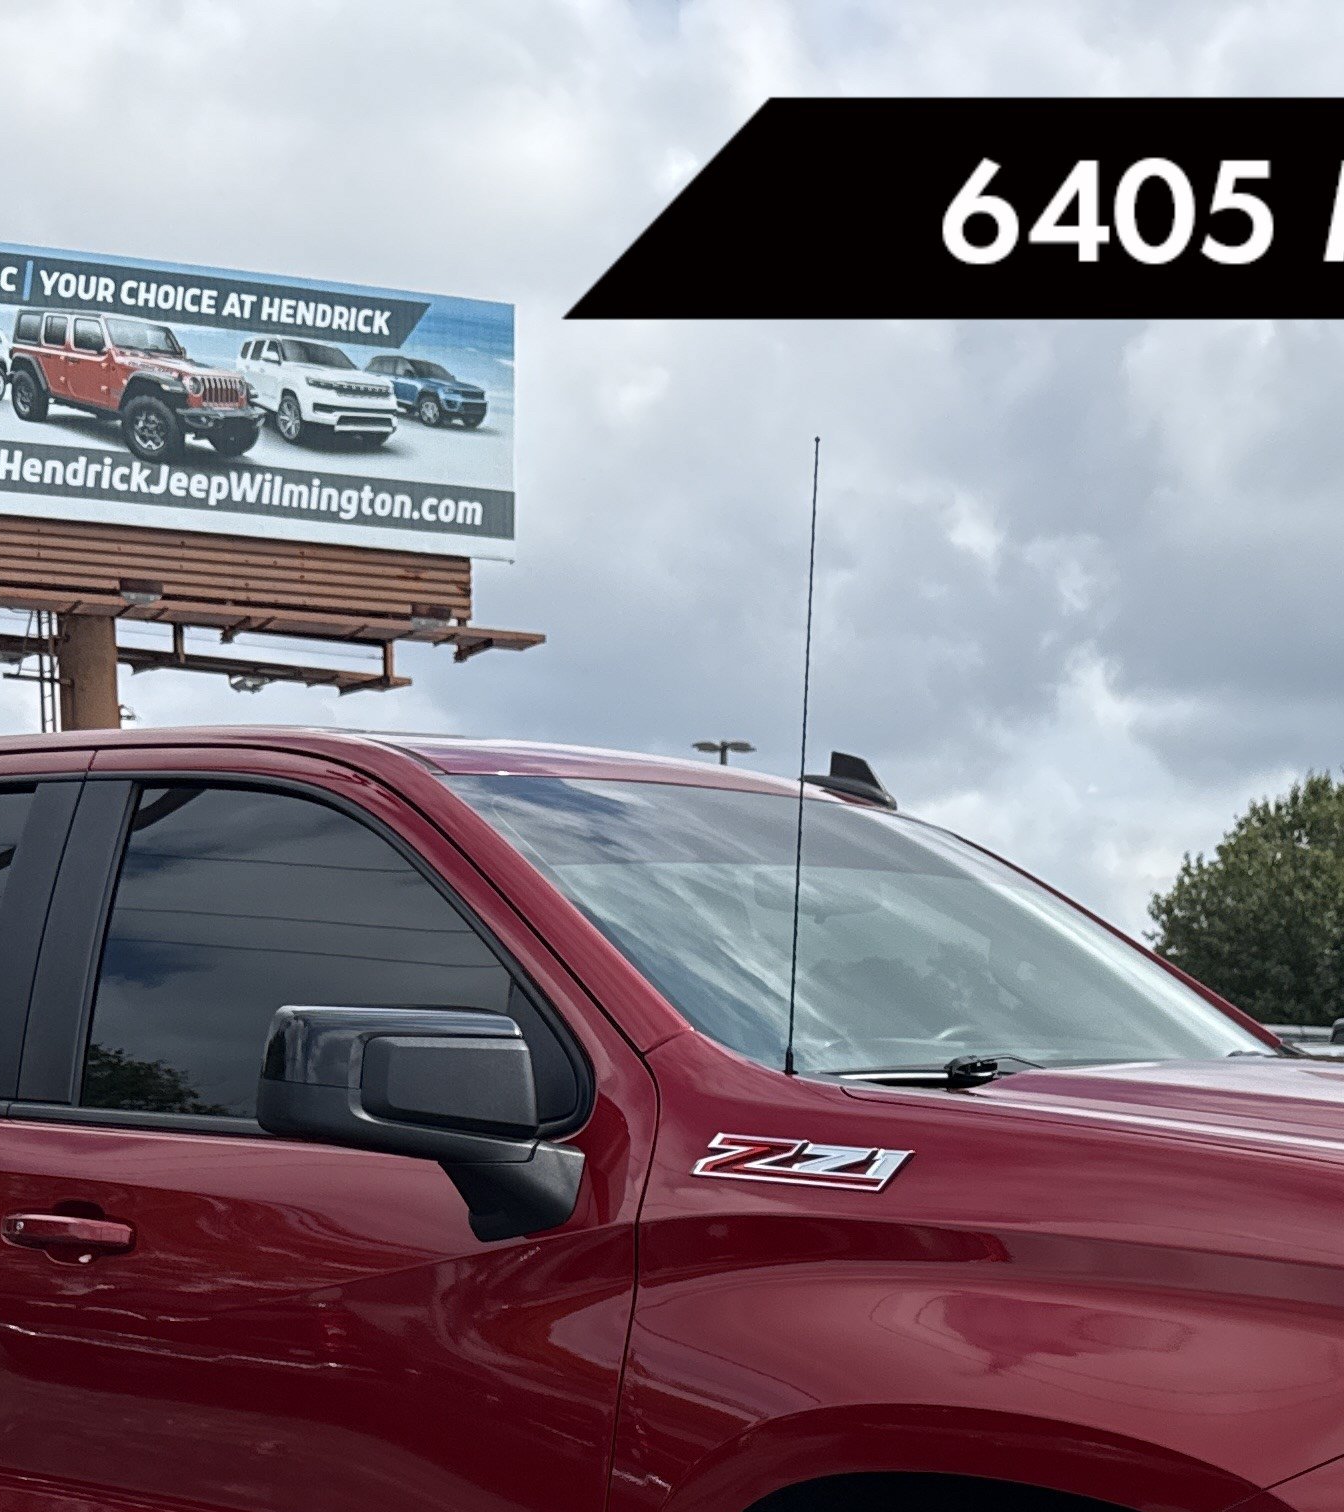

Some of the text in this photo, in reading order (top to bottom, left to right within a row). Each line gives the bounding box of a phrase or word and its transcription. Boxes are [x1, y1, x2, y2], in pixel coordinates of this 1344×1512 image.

[40, 269, 392, 336] YOUR CHOICE AT HENDRICK
[690, 1132, 916, 1194] Z71
